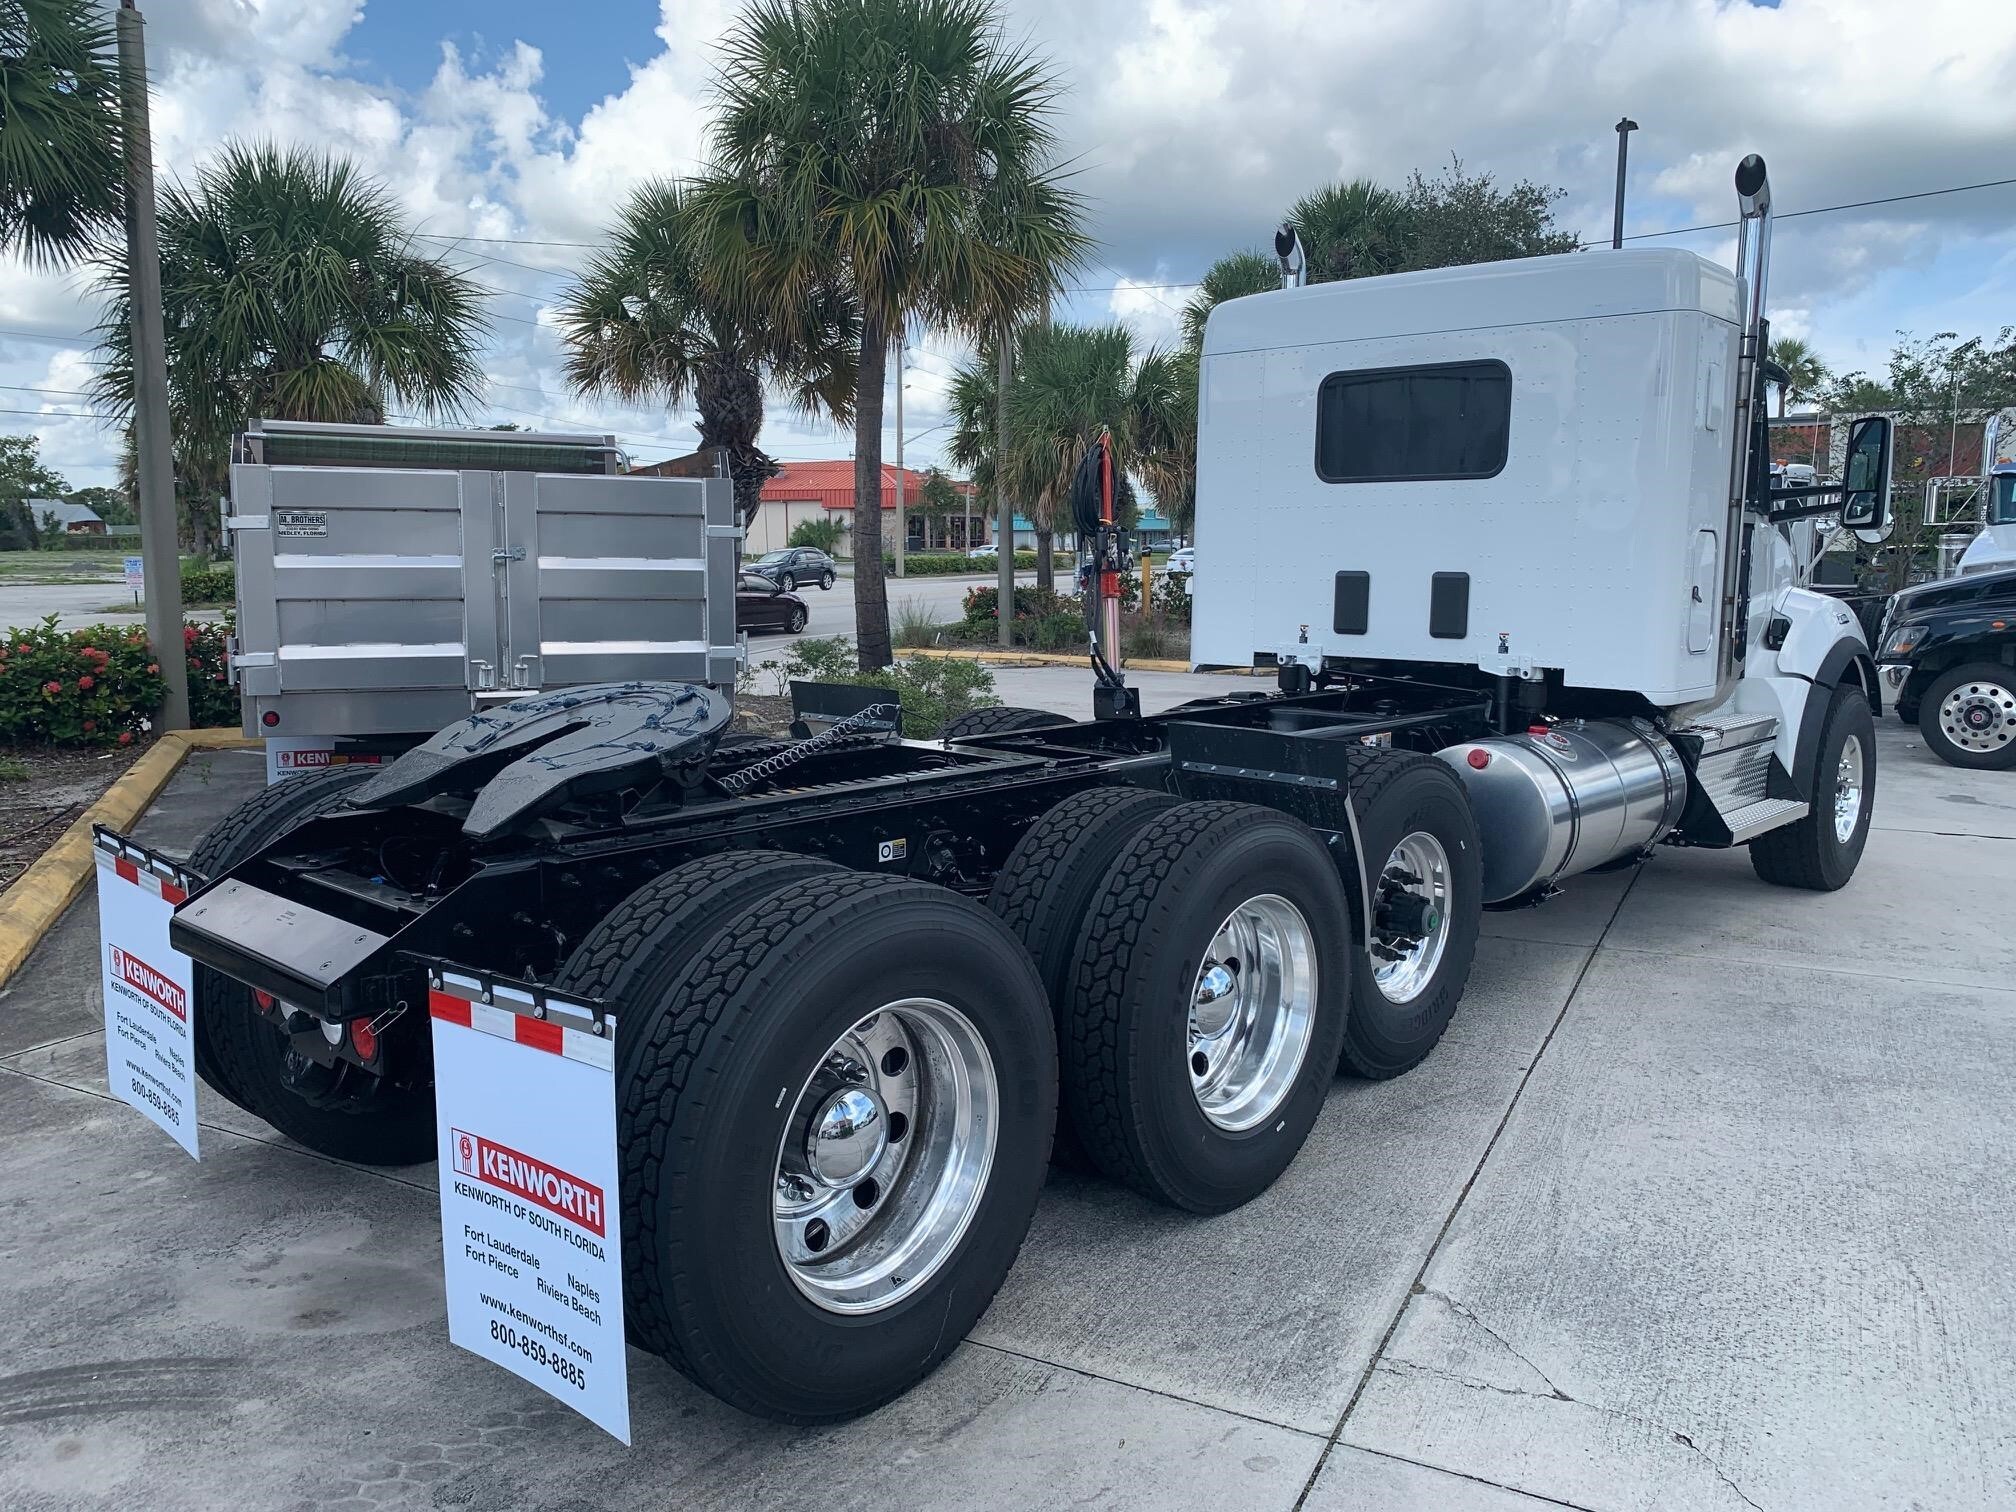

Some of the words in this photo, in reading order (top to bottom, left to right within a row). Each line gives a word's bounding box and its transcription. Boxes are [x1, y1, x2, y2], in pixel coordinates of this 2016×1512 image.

[290, 515, 324, 524] BROTHERS
[111, 980, 142, 1006] KENWORTH
[142, 998, 149, 1010] OF
[150, 1003, 167, 1022] SOUTH
[167, 1016, 187, 1040] FLORIDA
[125, 957, 185, 1015] KENWORTH
[117, 1011, 128, 1026] Fort
[129, 1017, 157, 1044] Lauderdale
[169, 1046, 185, 1068] Naples
[117, 1025, 129, 1041] Fort
[130, 1031, 147, 1051] Pierce
[155, 1048, 171, 1070] Riviera
[171, 1062, 186, 1083] Beach
[131, 1077, 180, 1127] 800-859-8885
[482, 1145, 601, 1227] KENWORTH
[454, 1180, 512, 1215] KENWORTH
[513, 1204, 527, 1221] OF
[529, 1210, 562, 1239] SOUTH
[564, 1227, 606, 1263] FLORIDA
[464, 1224, 486, 1245] Fort
[487, 1233, 541, 1270] Lauderdale
[567, 1272, 601, 1304] Naples
[465, 1244, 486, 1265] Fort
[488, 1253, 520, 1279] Pierce
[537, 1276, 570, 1307] Riviera
[571, 1295, 602, 1327] Beach
[479, 1292, 593, 1364] www.kenworthsf.com
[490, 1319, 586, 1391] 800-859-8885
